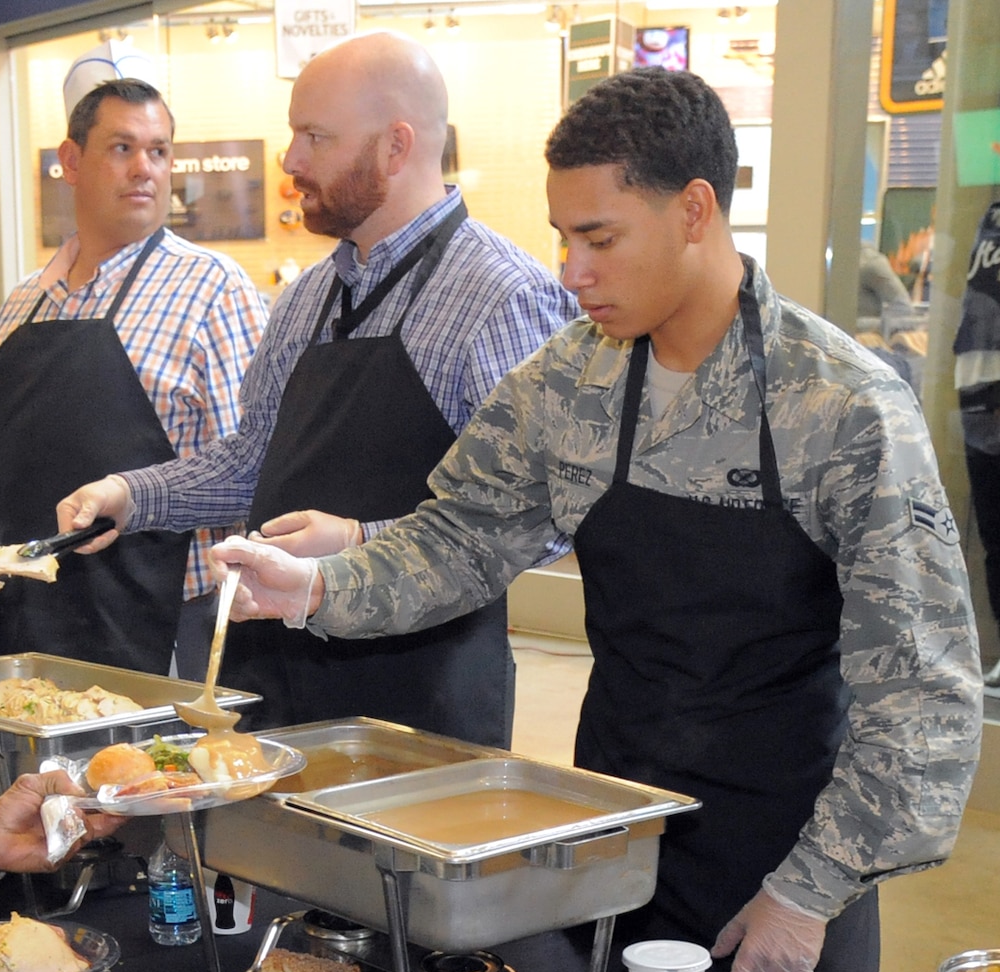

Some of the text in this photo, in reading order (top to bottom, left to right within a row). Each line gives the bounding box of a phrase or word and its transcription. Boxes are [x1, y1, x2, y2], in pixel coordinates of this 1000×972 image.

[282, 23, 348, 37] NOVELTIES
[202, 153, 251, 173] store
[559, 460, 592, 487] PEREZ
[216, 897, 233, 905] zero
